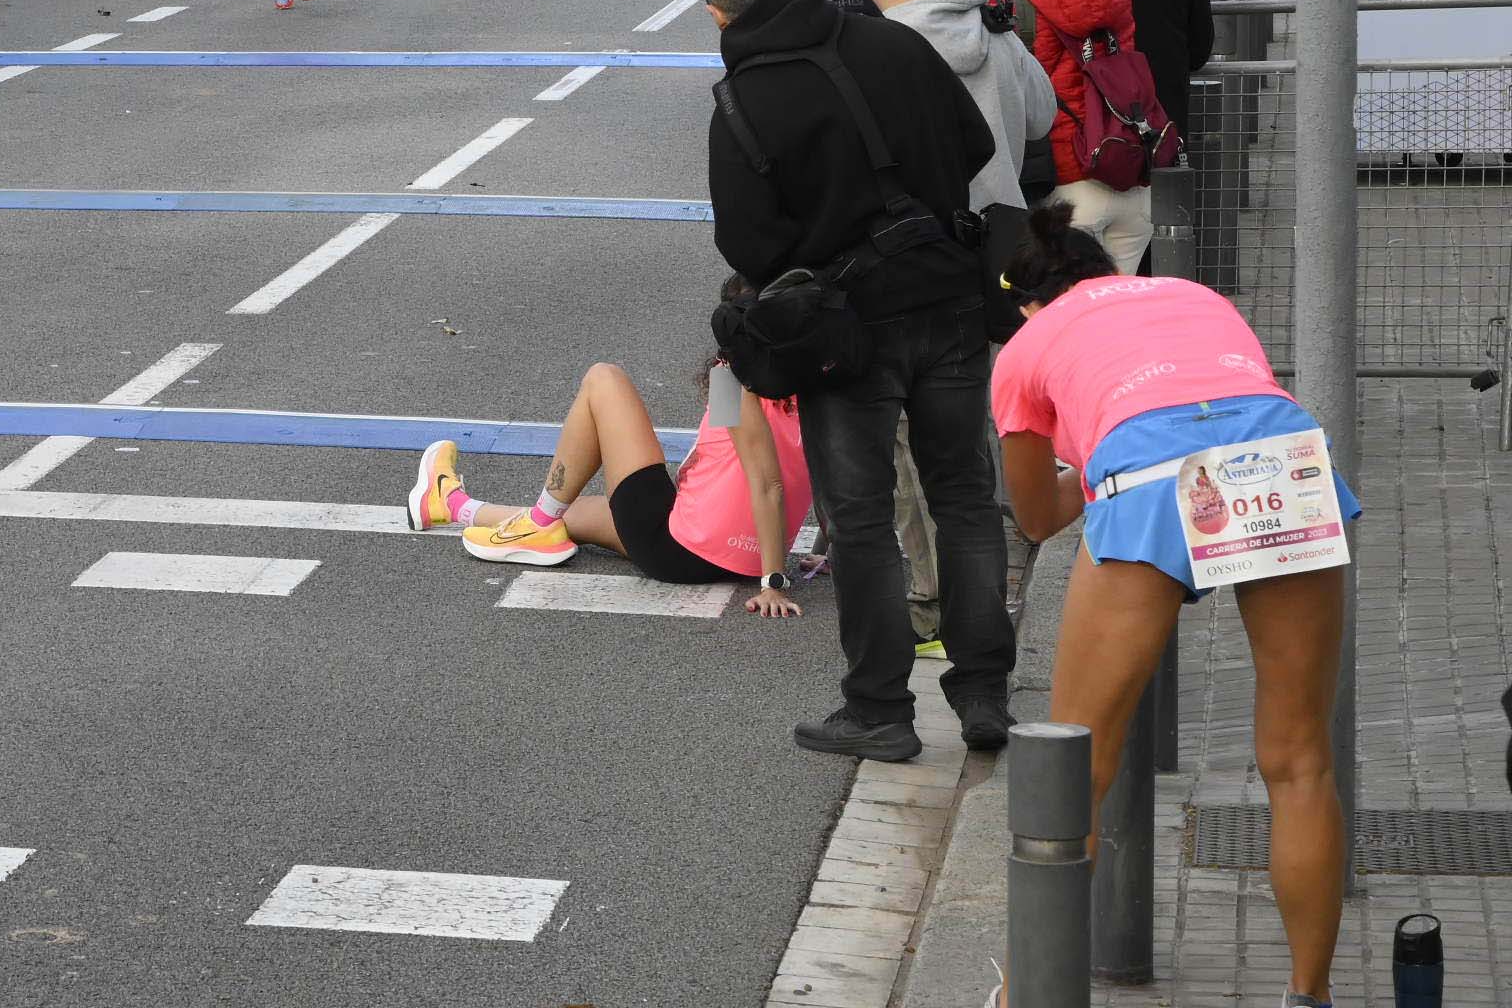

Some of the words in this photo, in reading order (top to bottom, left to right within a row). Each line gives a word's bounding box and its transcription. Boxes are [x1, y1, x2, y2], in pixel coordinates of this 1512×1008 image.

[1287, 448, 1316, 461] SUMA
[1232, 492, 1284, 517] 016
[1243, 517, 1282, 534] 10984
[727, 537, 760, 554] OYSH
[1206, 542, 1248, 556] CARRERA
[1249, 538, 1262, 548] DE
[1264, 536, 1275, 545] LA
[1276, 532, 1305, 544] MUJER
[1289, 546, 1336, 562] Santander
[1206, 559, 1253, 577] OYSHO
